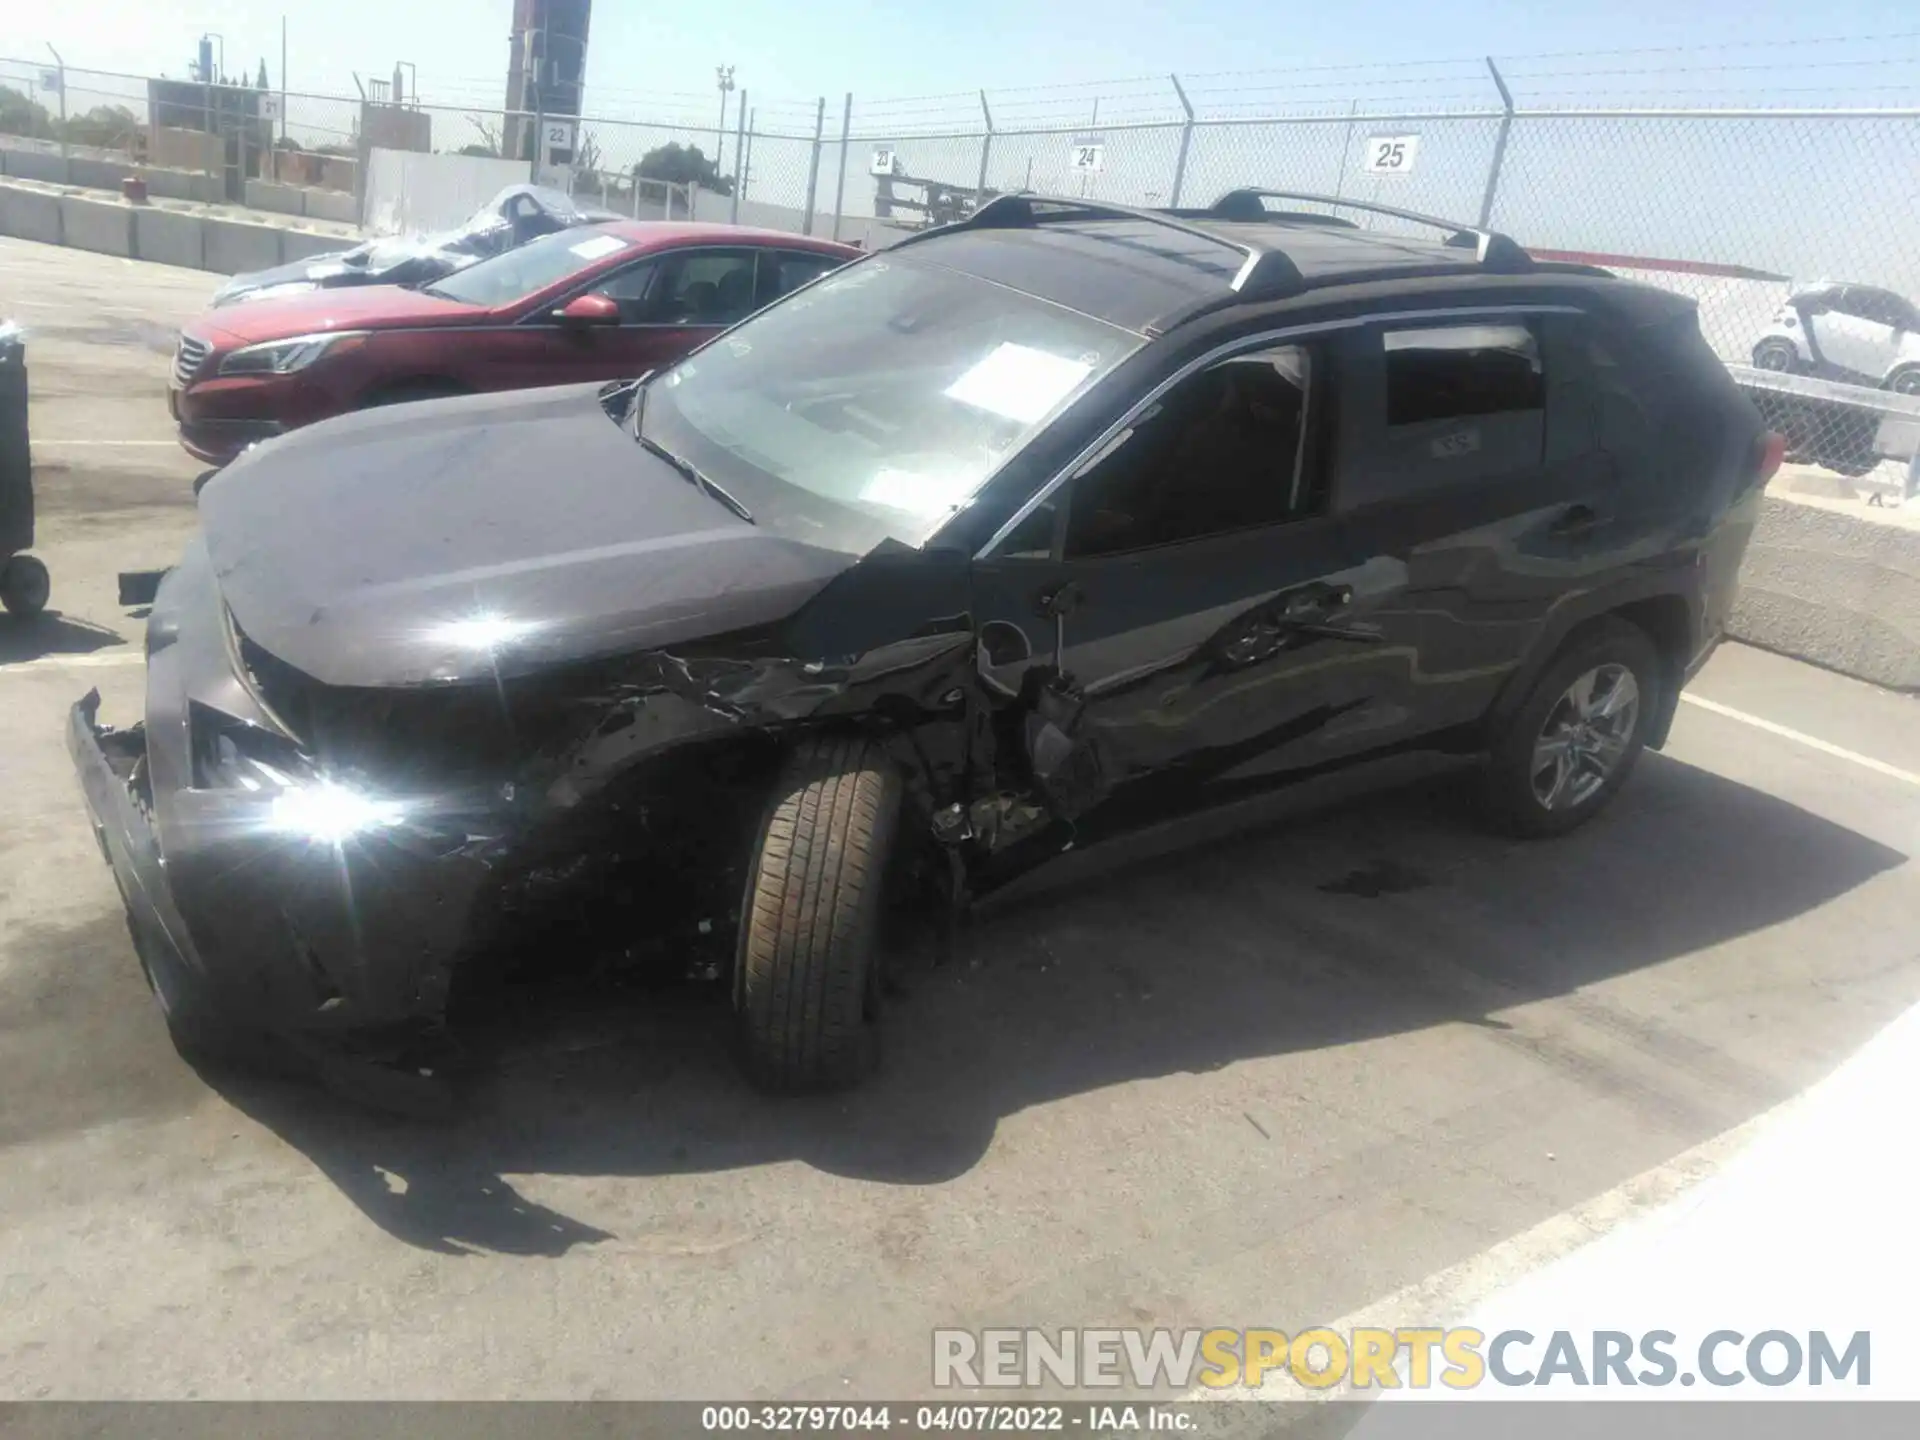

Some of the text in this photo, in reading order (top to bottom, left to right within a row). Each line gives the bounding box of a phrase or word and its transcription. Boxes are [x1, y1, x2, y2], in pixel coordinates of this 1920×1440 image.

[549, 128, 564, 142] 22
[1078, 147, 1095, 166] 24
[1375, 142, 1406, 168] 25
